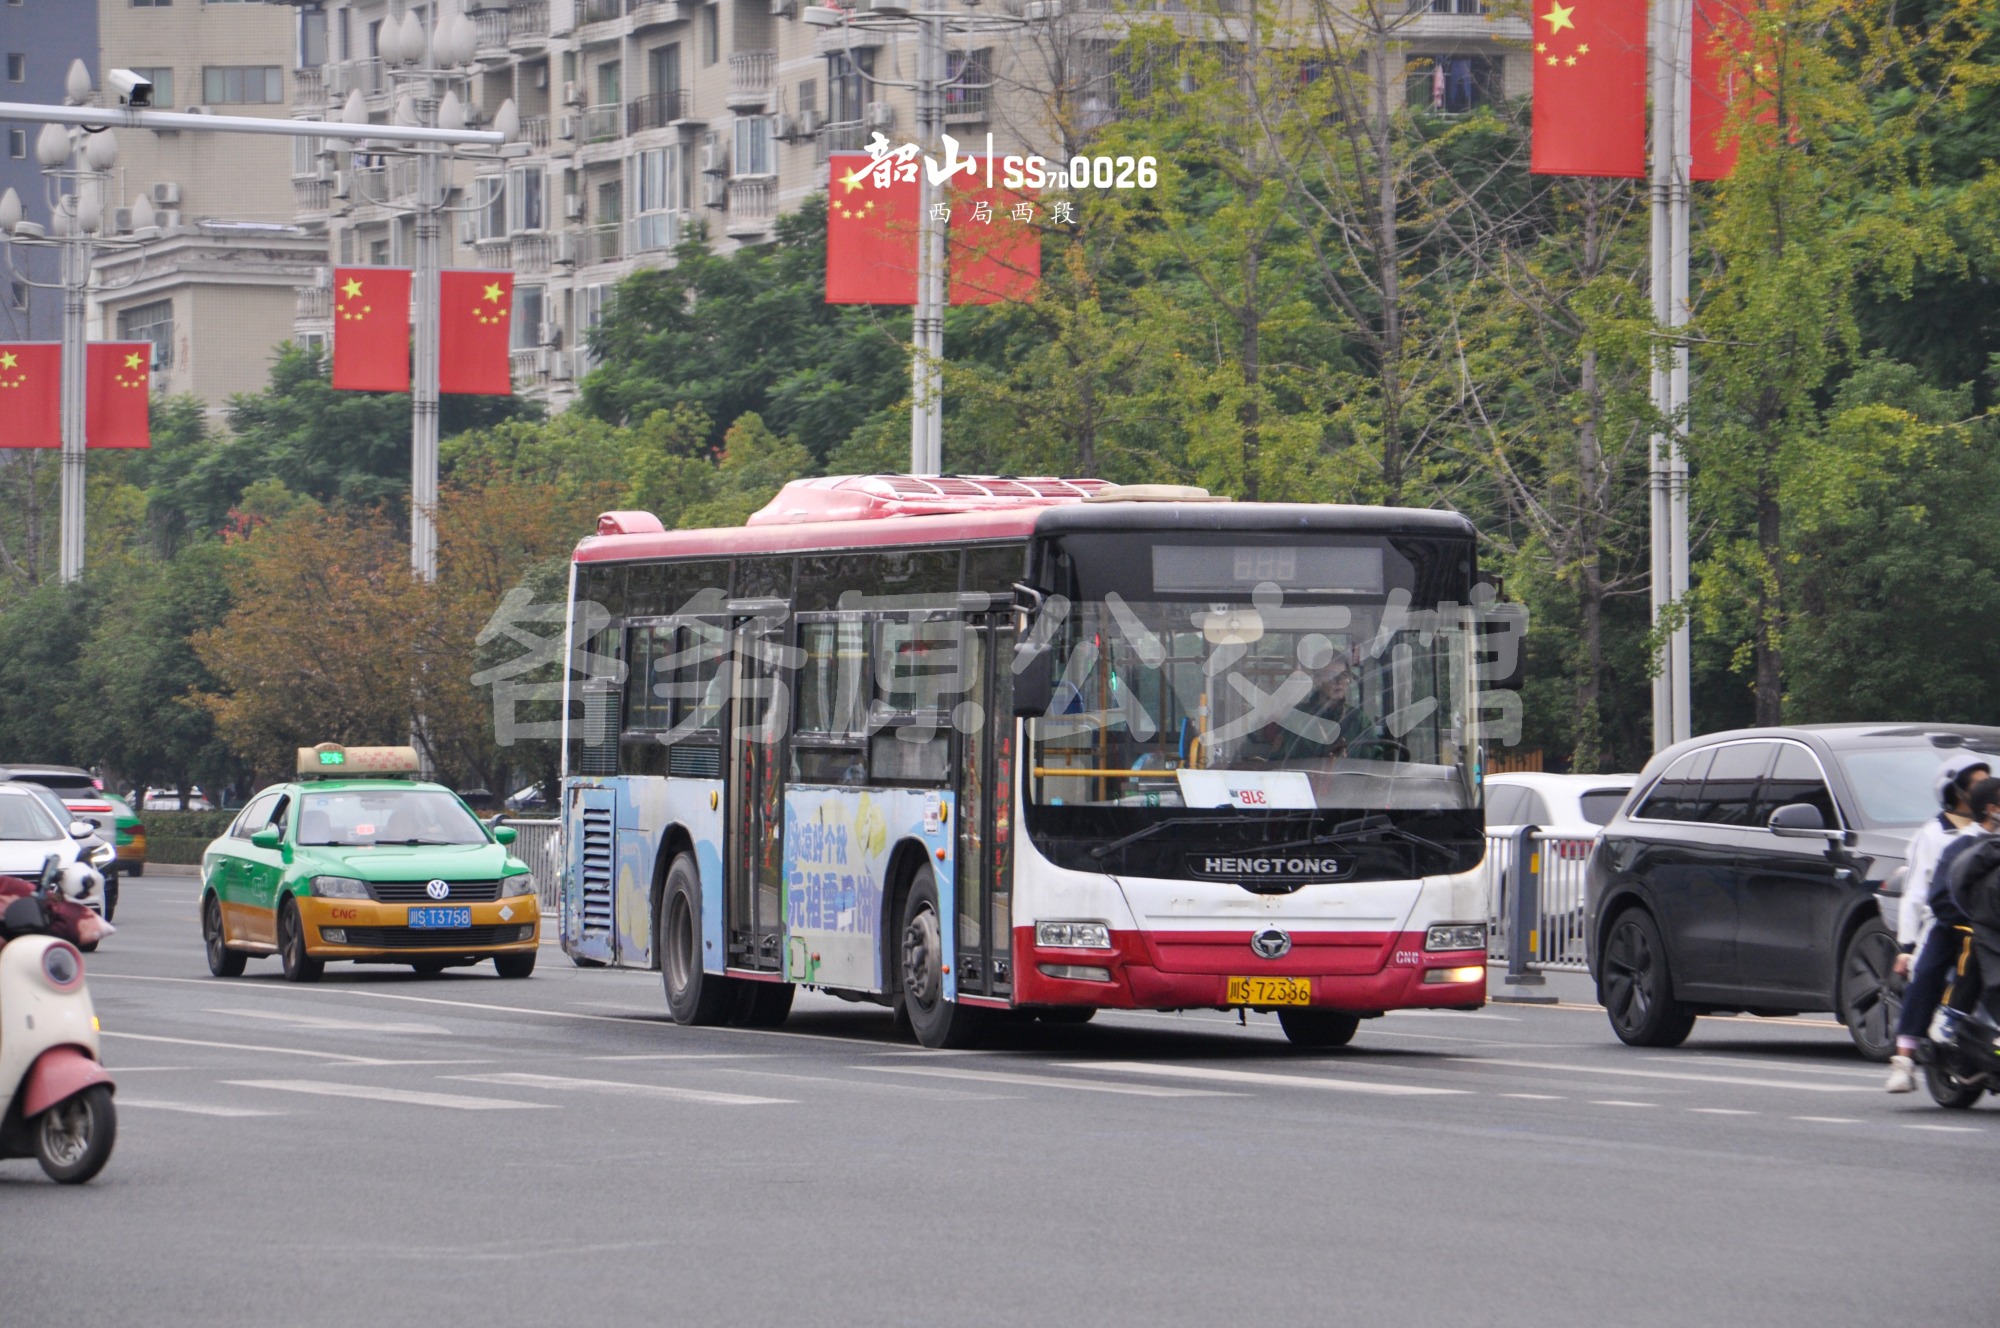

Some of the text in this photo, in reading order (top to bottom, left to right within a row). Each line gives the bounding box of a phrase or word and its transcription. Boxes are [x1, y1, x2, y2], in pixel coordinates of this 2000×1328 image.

[1205, 858, 1338, 874] HENGTONG
[331, 908, 358, 919] CNG
[1396, 950, 1419, 965] CNG
